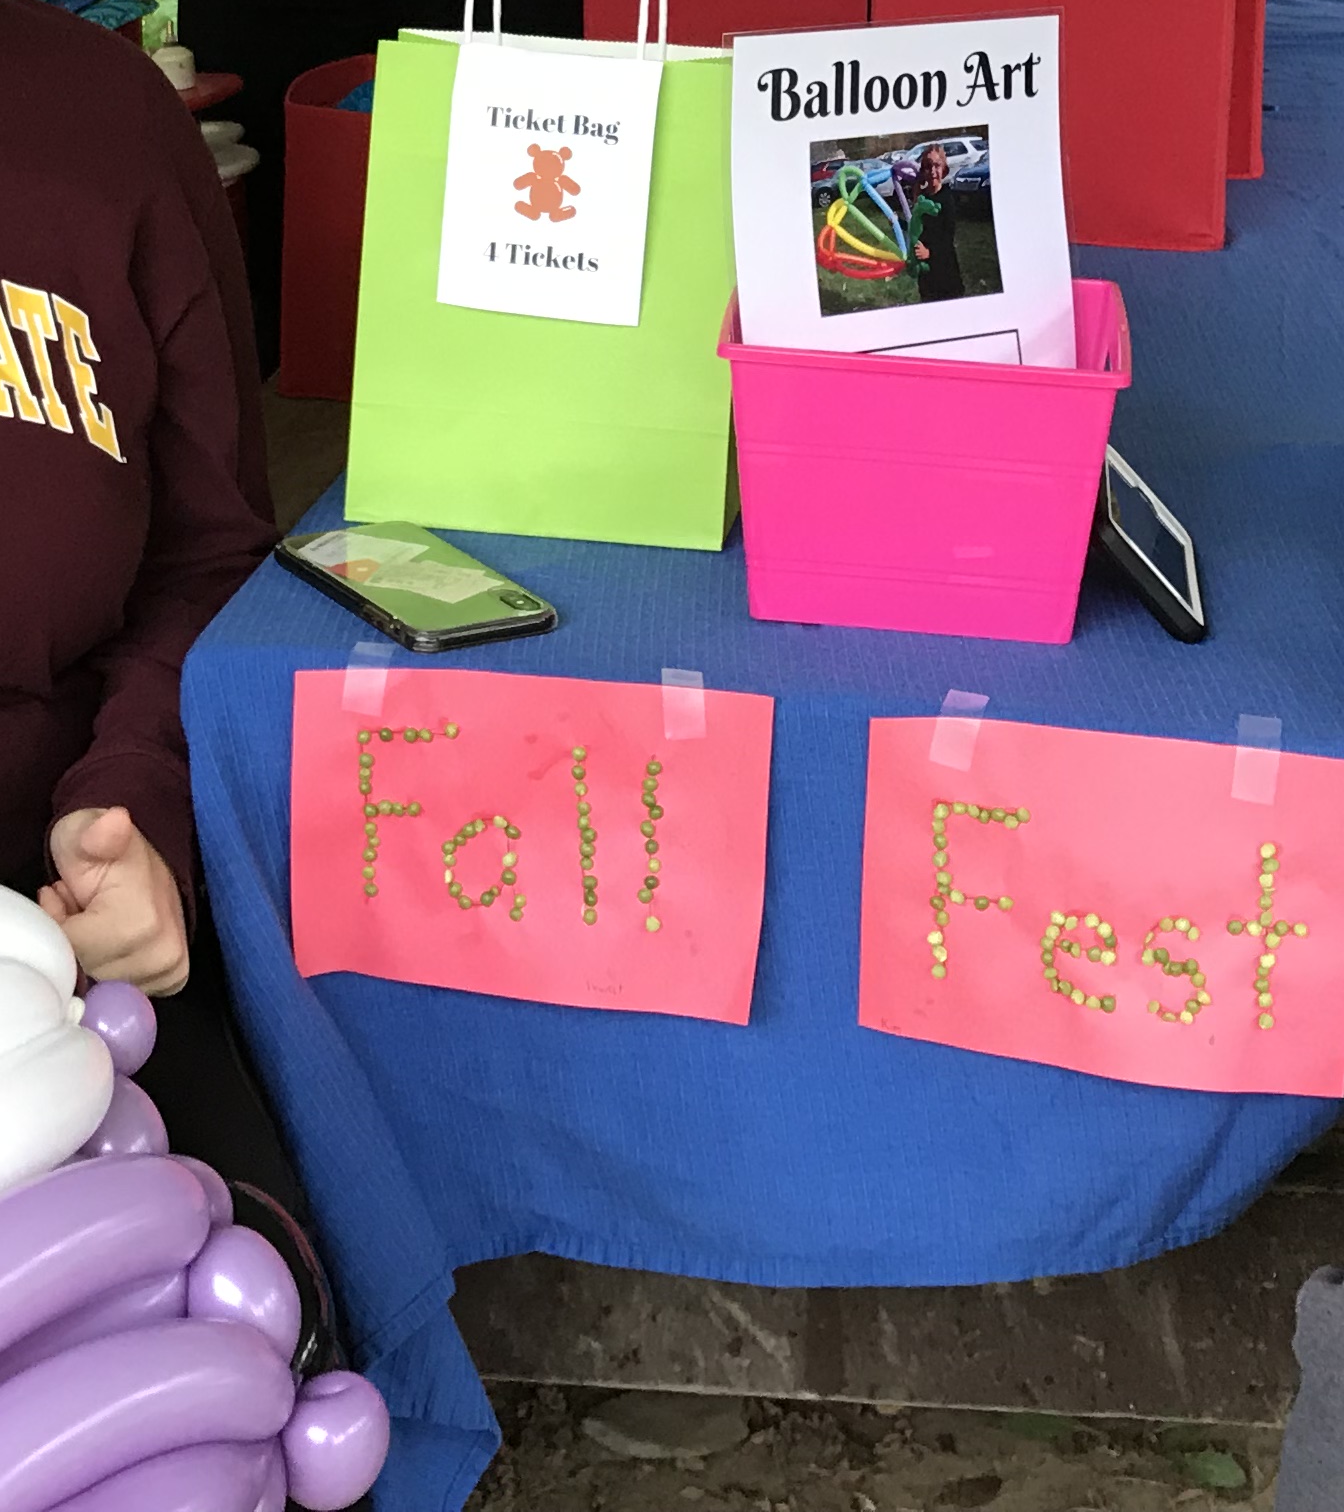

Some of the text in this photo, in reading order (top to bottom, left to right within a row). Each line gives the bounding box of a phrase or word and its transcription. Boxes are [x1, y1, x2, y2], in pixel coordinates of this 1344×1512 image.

[757, 51, 1042, 122] Balloon Art
[486, 105, 621, 145] Ticket Bag
[483, 241, 599, 273] 4 Tickets
[356, 718, 664, 935] Fall
[926, 796, 1312, 1031] Fest
